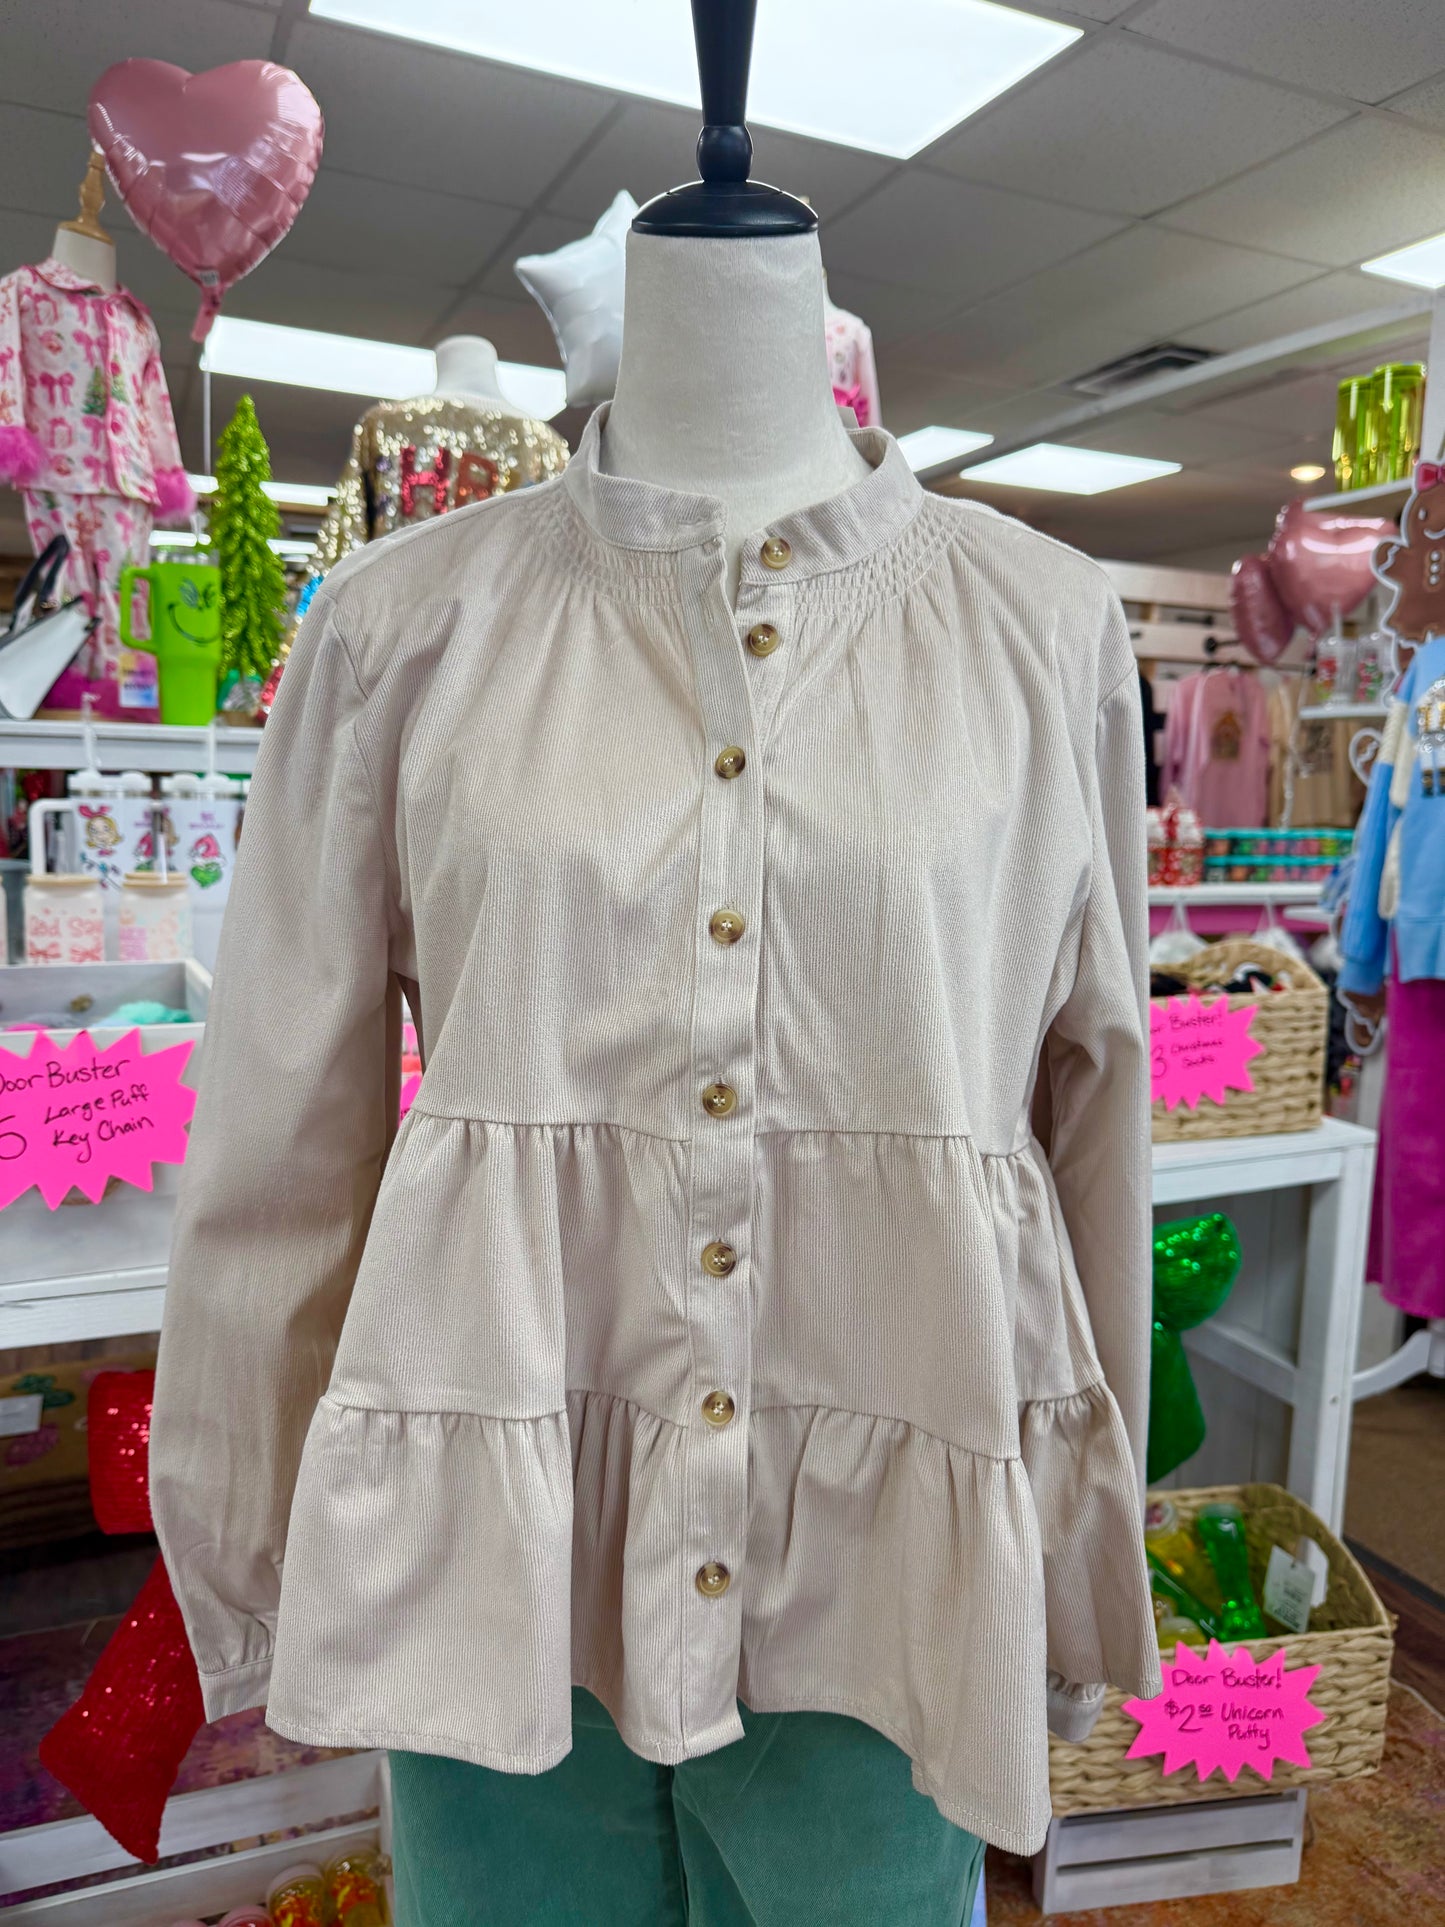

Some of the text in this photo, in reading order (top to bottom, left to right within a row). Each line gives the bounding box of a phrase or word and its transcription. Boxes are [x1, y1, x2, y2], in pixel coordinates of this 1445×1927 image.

[46, 1057, 130, 1088] Buster
[44, 1097, 106, 1124] Large
[110, 1083, 150, 1108] Puff
[53, 1116, 155, 1164] Key Chain
[1171, 1667, 1282, 1689] Door Buster!
[1220, 1701, 1285, 1721] Unicorn
[1227, 1723, 1271, 1750] Putty
